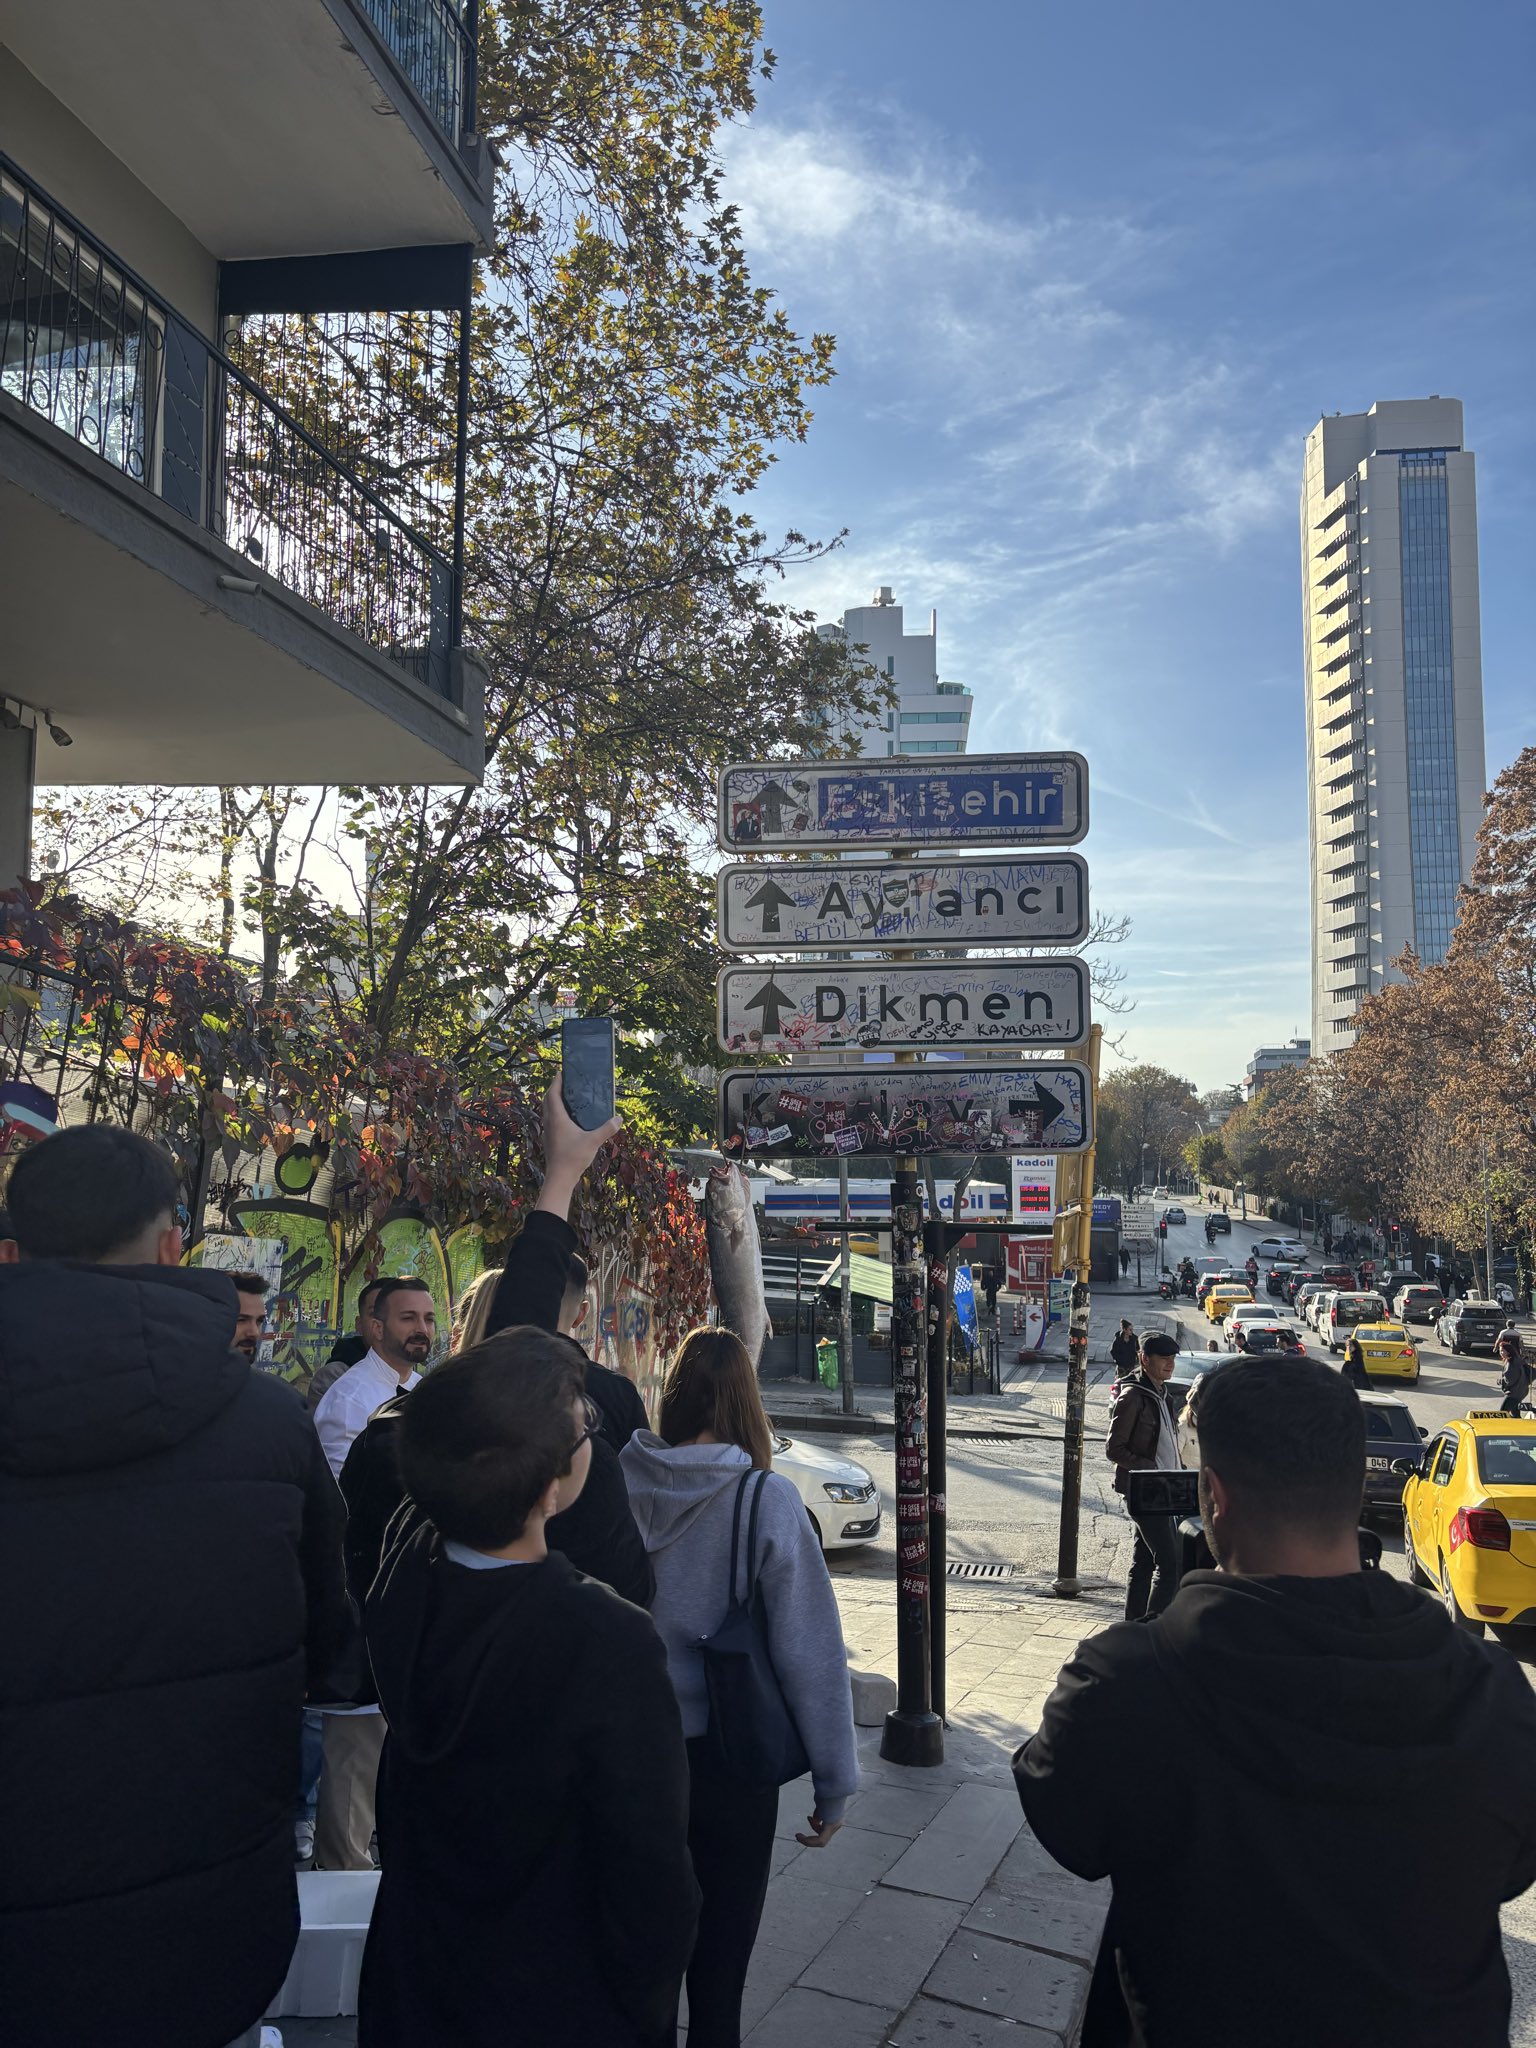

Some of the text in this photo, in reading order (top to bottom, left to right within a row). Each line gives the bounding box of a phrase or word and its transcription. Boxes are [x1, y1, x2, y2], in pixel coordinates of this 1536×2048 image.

[815, 984, 1052, 1023] Dikmen
[923, 1195, 983, 1209] doil
[1371, 1458, 1387, 1468] 046
